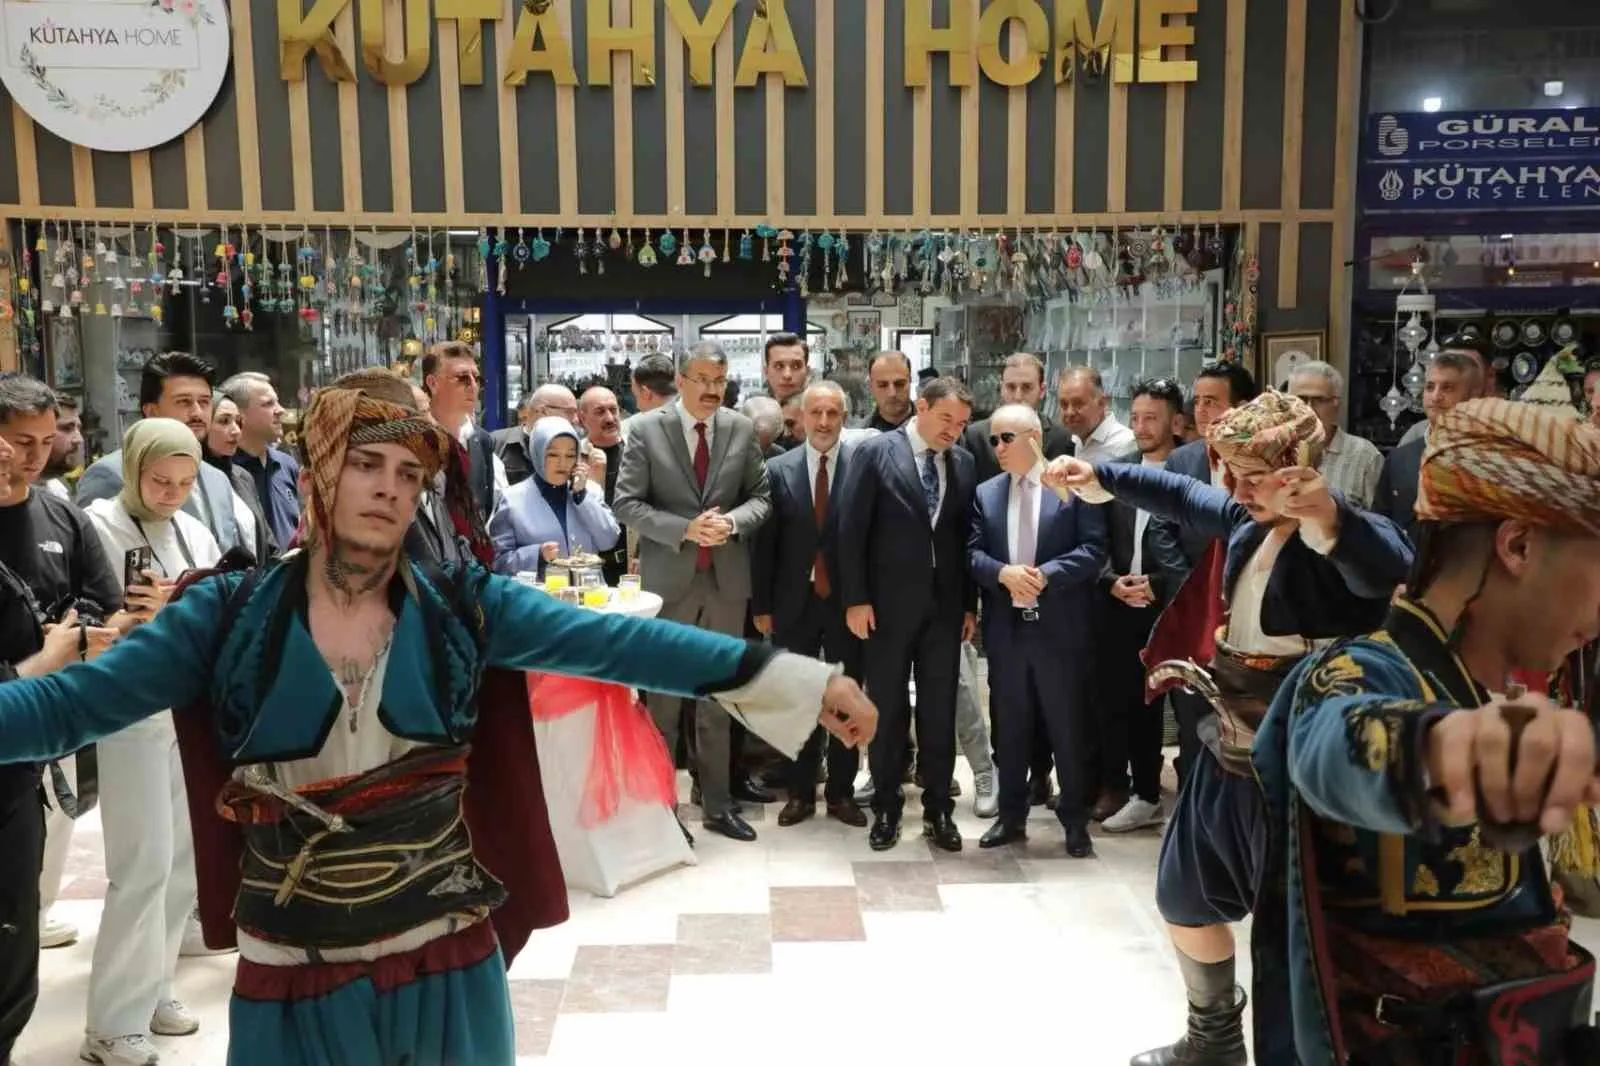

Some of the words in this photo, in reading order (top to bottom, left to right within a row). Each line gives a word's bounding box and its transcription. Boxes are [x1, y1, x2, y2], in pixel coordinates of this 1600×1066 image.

[125, 28, 182, 46] HOME
[904, 0, 1197, 86] HOME
[1437, 115, 1599, 135] GÜRAL
[1413, 164, 1600, 186] KÜTAHYA
[1413, 184, 1600, 200] PORSELEN
